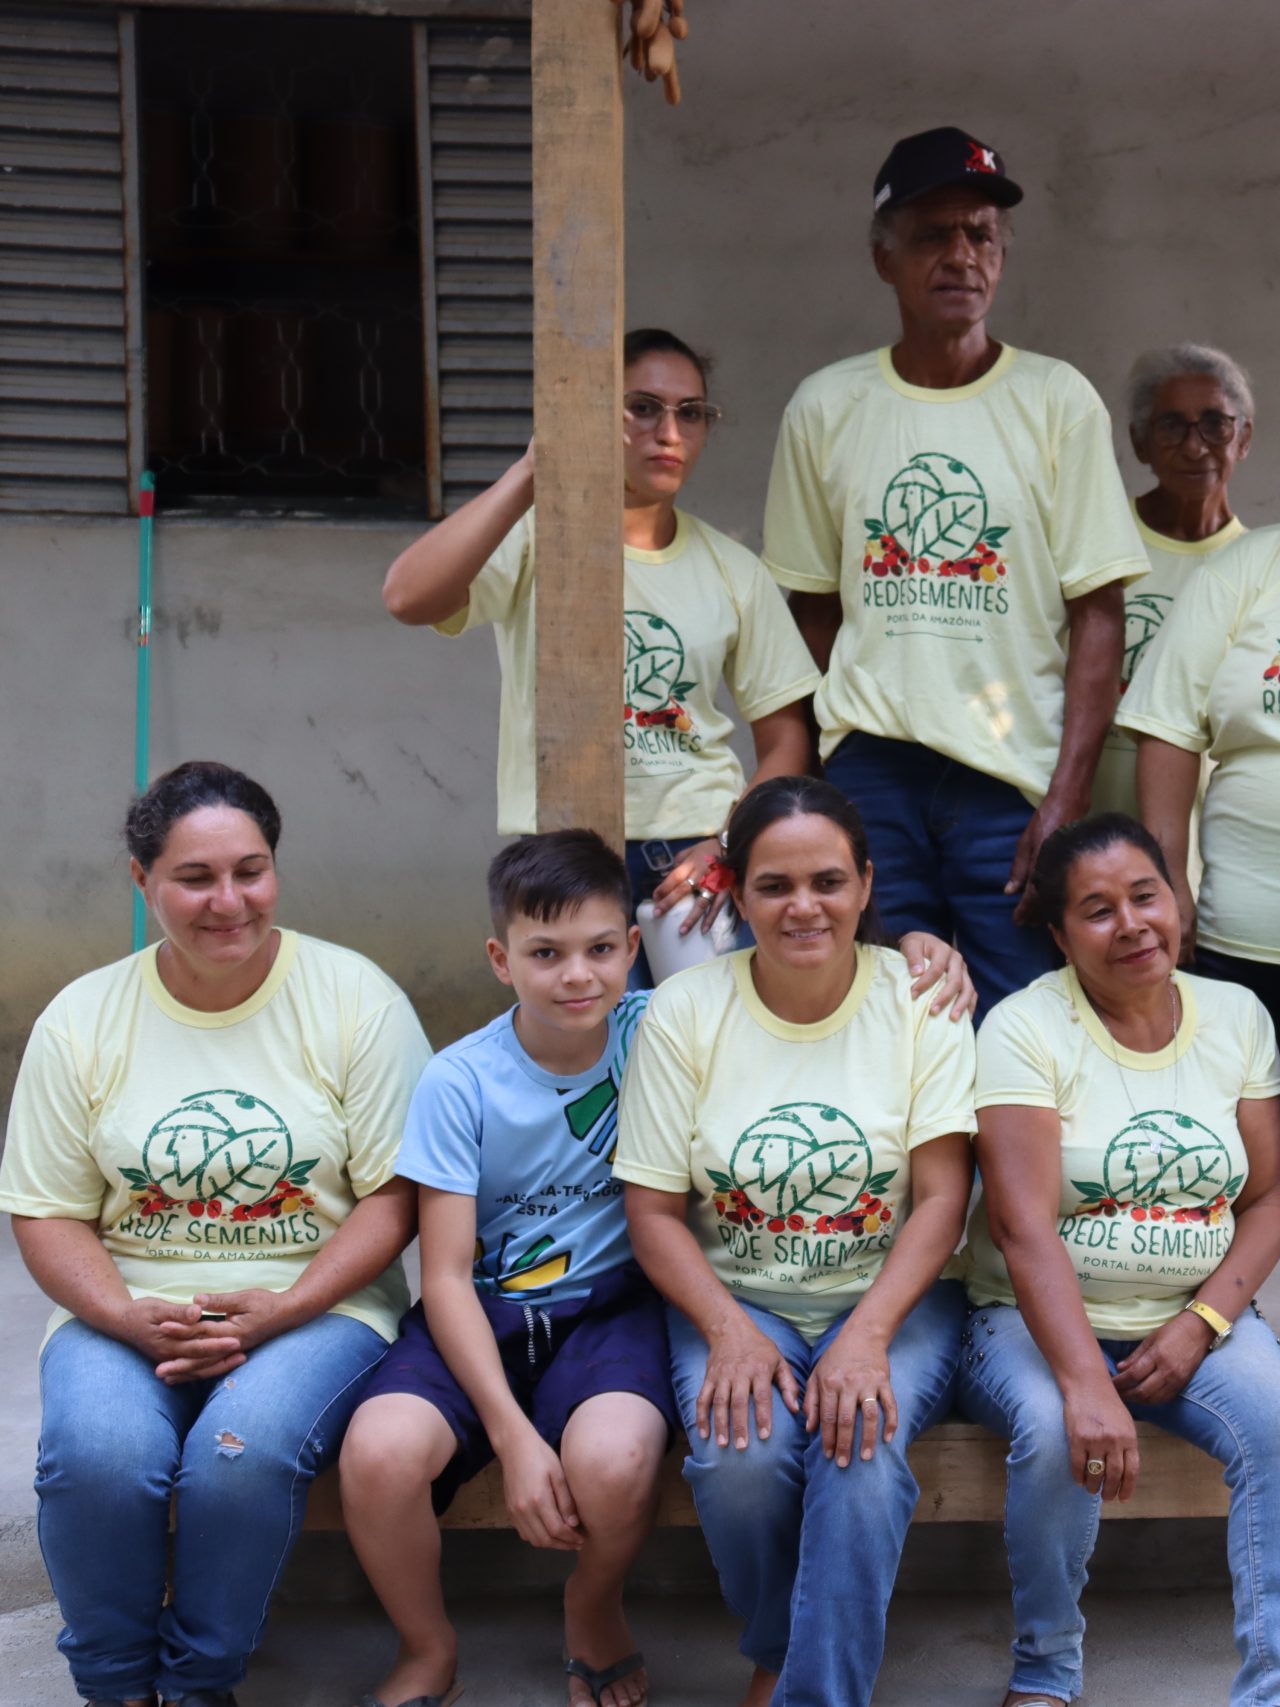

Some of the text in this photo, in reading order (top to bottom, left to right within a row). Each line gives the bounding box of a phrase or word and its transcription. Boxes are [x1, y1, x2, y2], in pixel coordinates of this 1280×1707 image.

[912, 613, 927, 622] DA
[517, 1204, 558, 1217] ESTÁ
[186, 1211, 321, 1245] SEMENTES
[1060, 1217, 1230, 1259] REDE SEMENTES
[193, 1249, 211, 1259] DA
[735, 1264, 774, 1280] PORTAL
[780, 1273, 795, 1284] DA
[1083, 1256, 1211, 1276] PORTAL DA AMAZÔNIA
